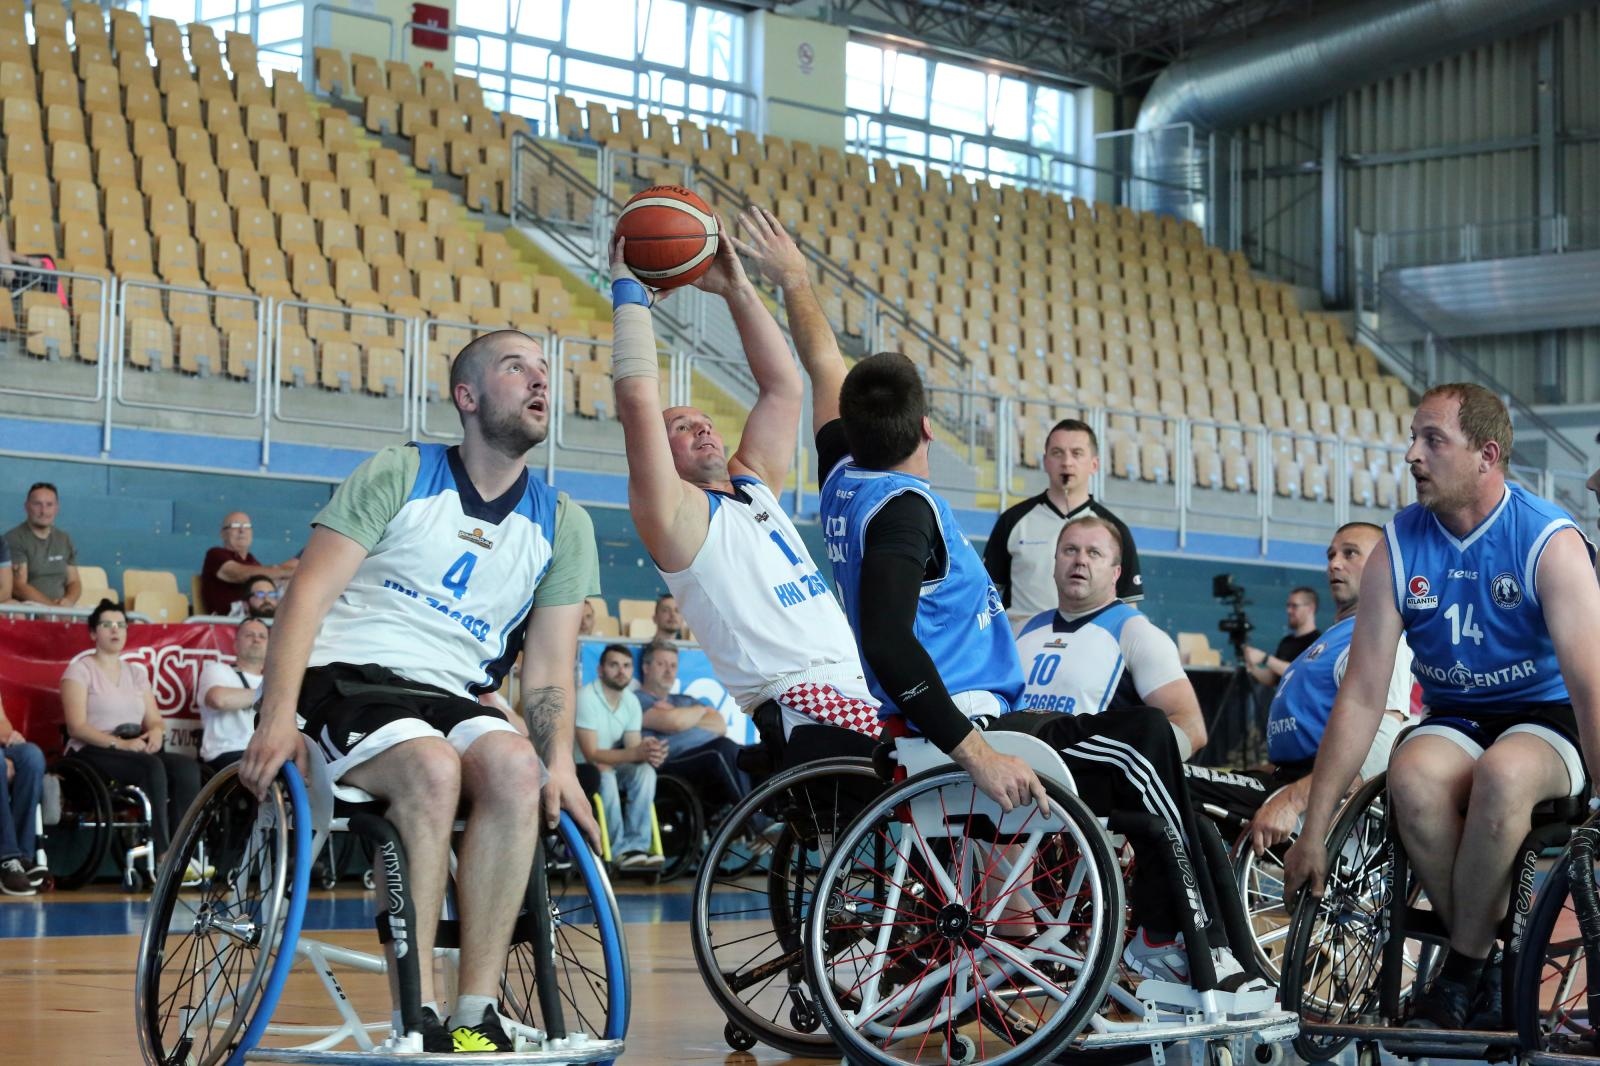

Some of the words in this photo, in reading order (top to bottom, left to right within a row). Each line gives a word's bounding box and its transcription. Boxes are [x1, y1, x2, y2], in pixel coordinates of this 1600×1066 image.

[836, 489, 856, 499] eus
[441, 551, 478, 600] 4
[1407, 596, 1437, 605] ATLANTIC
[1444, 603, 1484, 645] 14
[1028, 653, 1061, 686] 10
